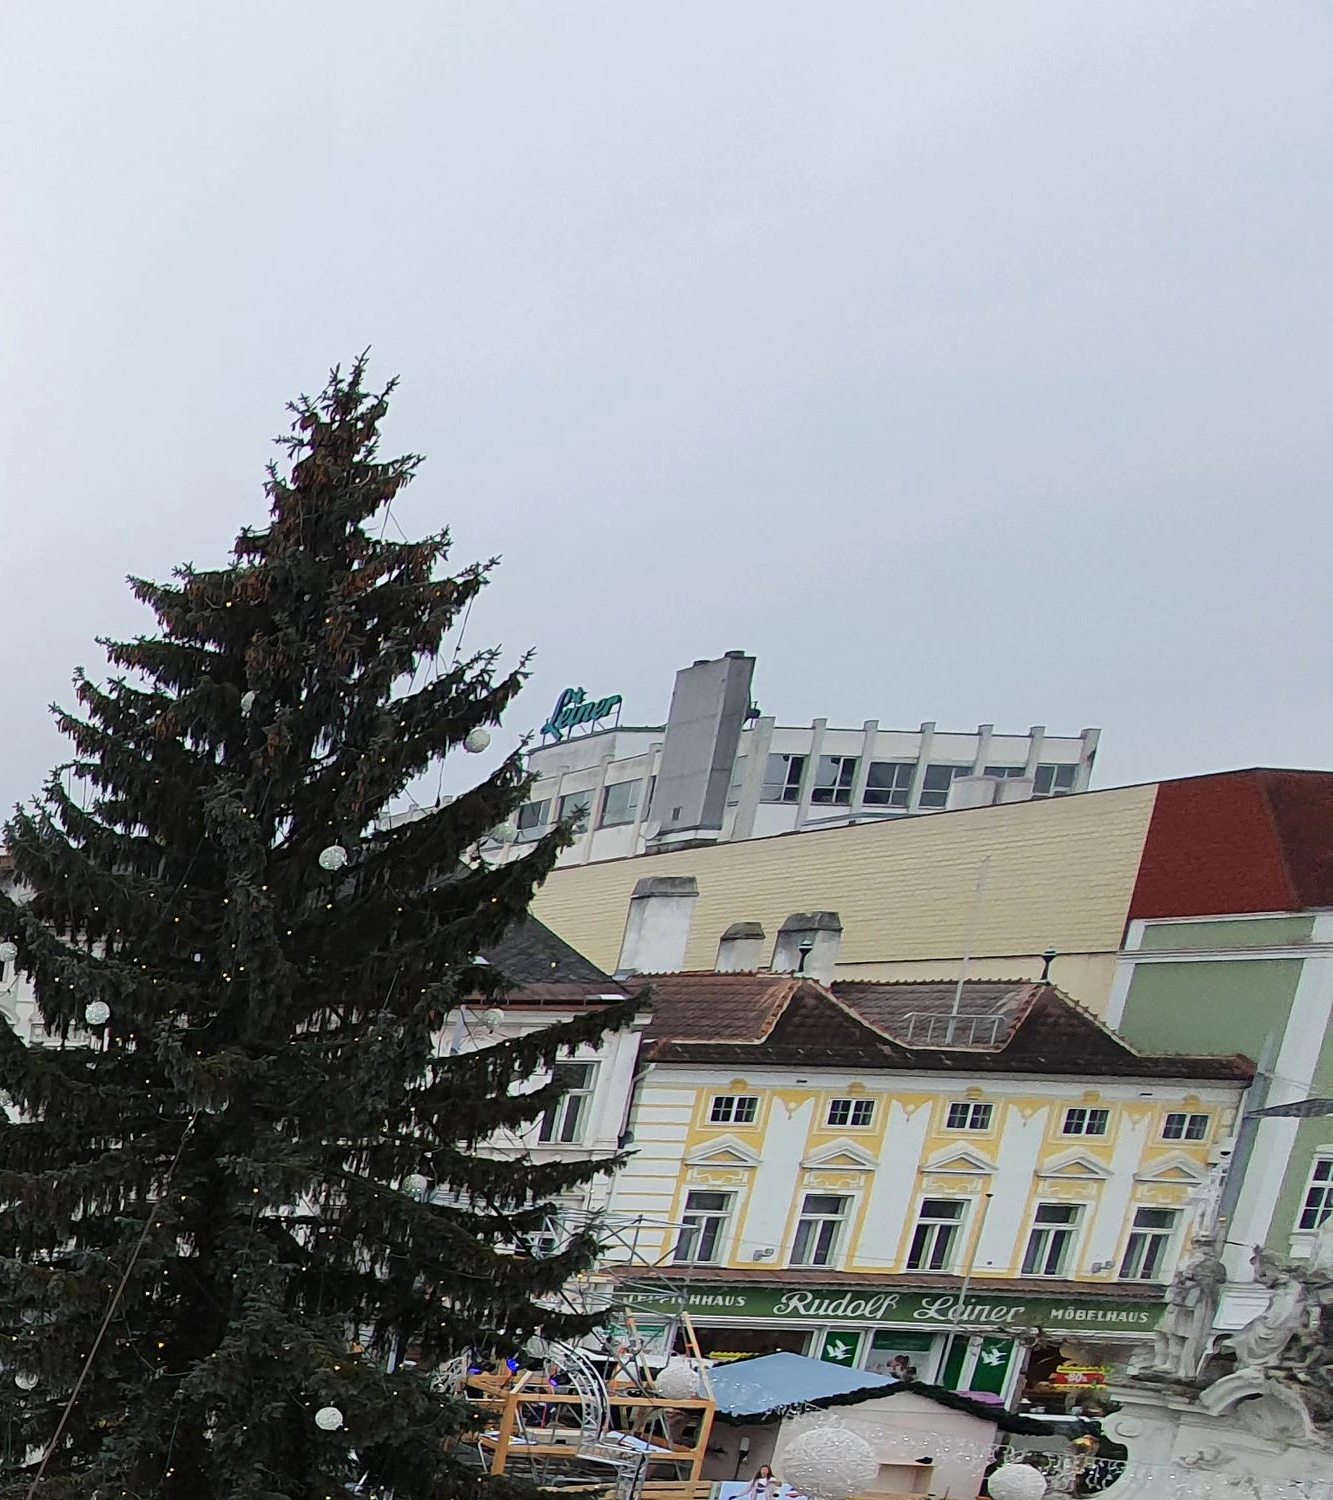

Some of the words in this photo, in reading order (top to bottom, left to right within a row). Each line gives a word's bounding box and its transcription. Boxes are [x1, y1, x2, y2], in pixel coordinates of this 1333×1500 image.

[540, 687, 623, 740] Leiner
[773, 1290, 900, 1320] Rudolf
[913, 1296, 1026, 1323] Leiner
[1050, 1306, 1151, 1323] MÖBELHAUS
